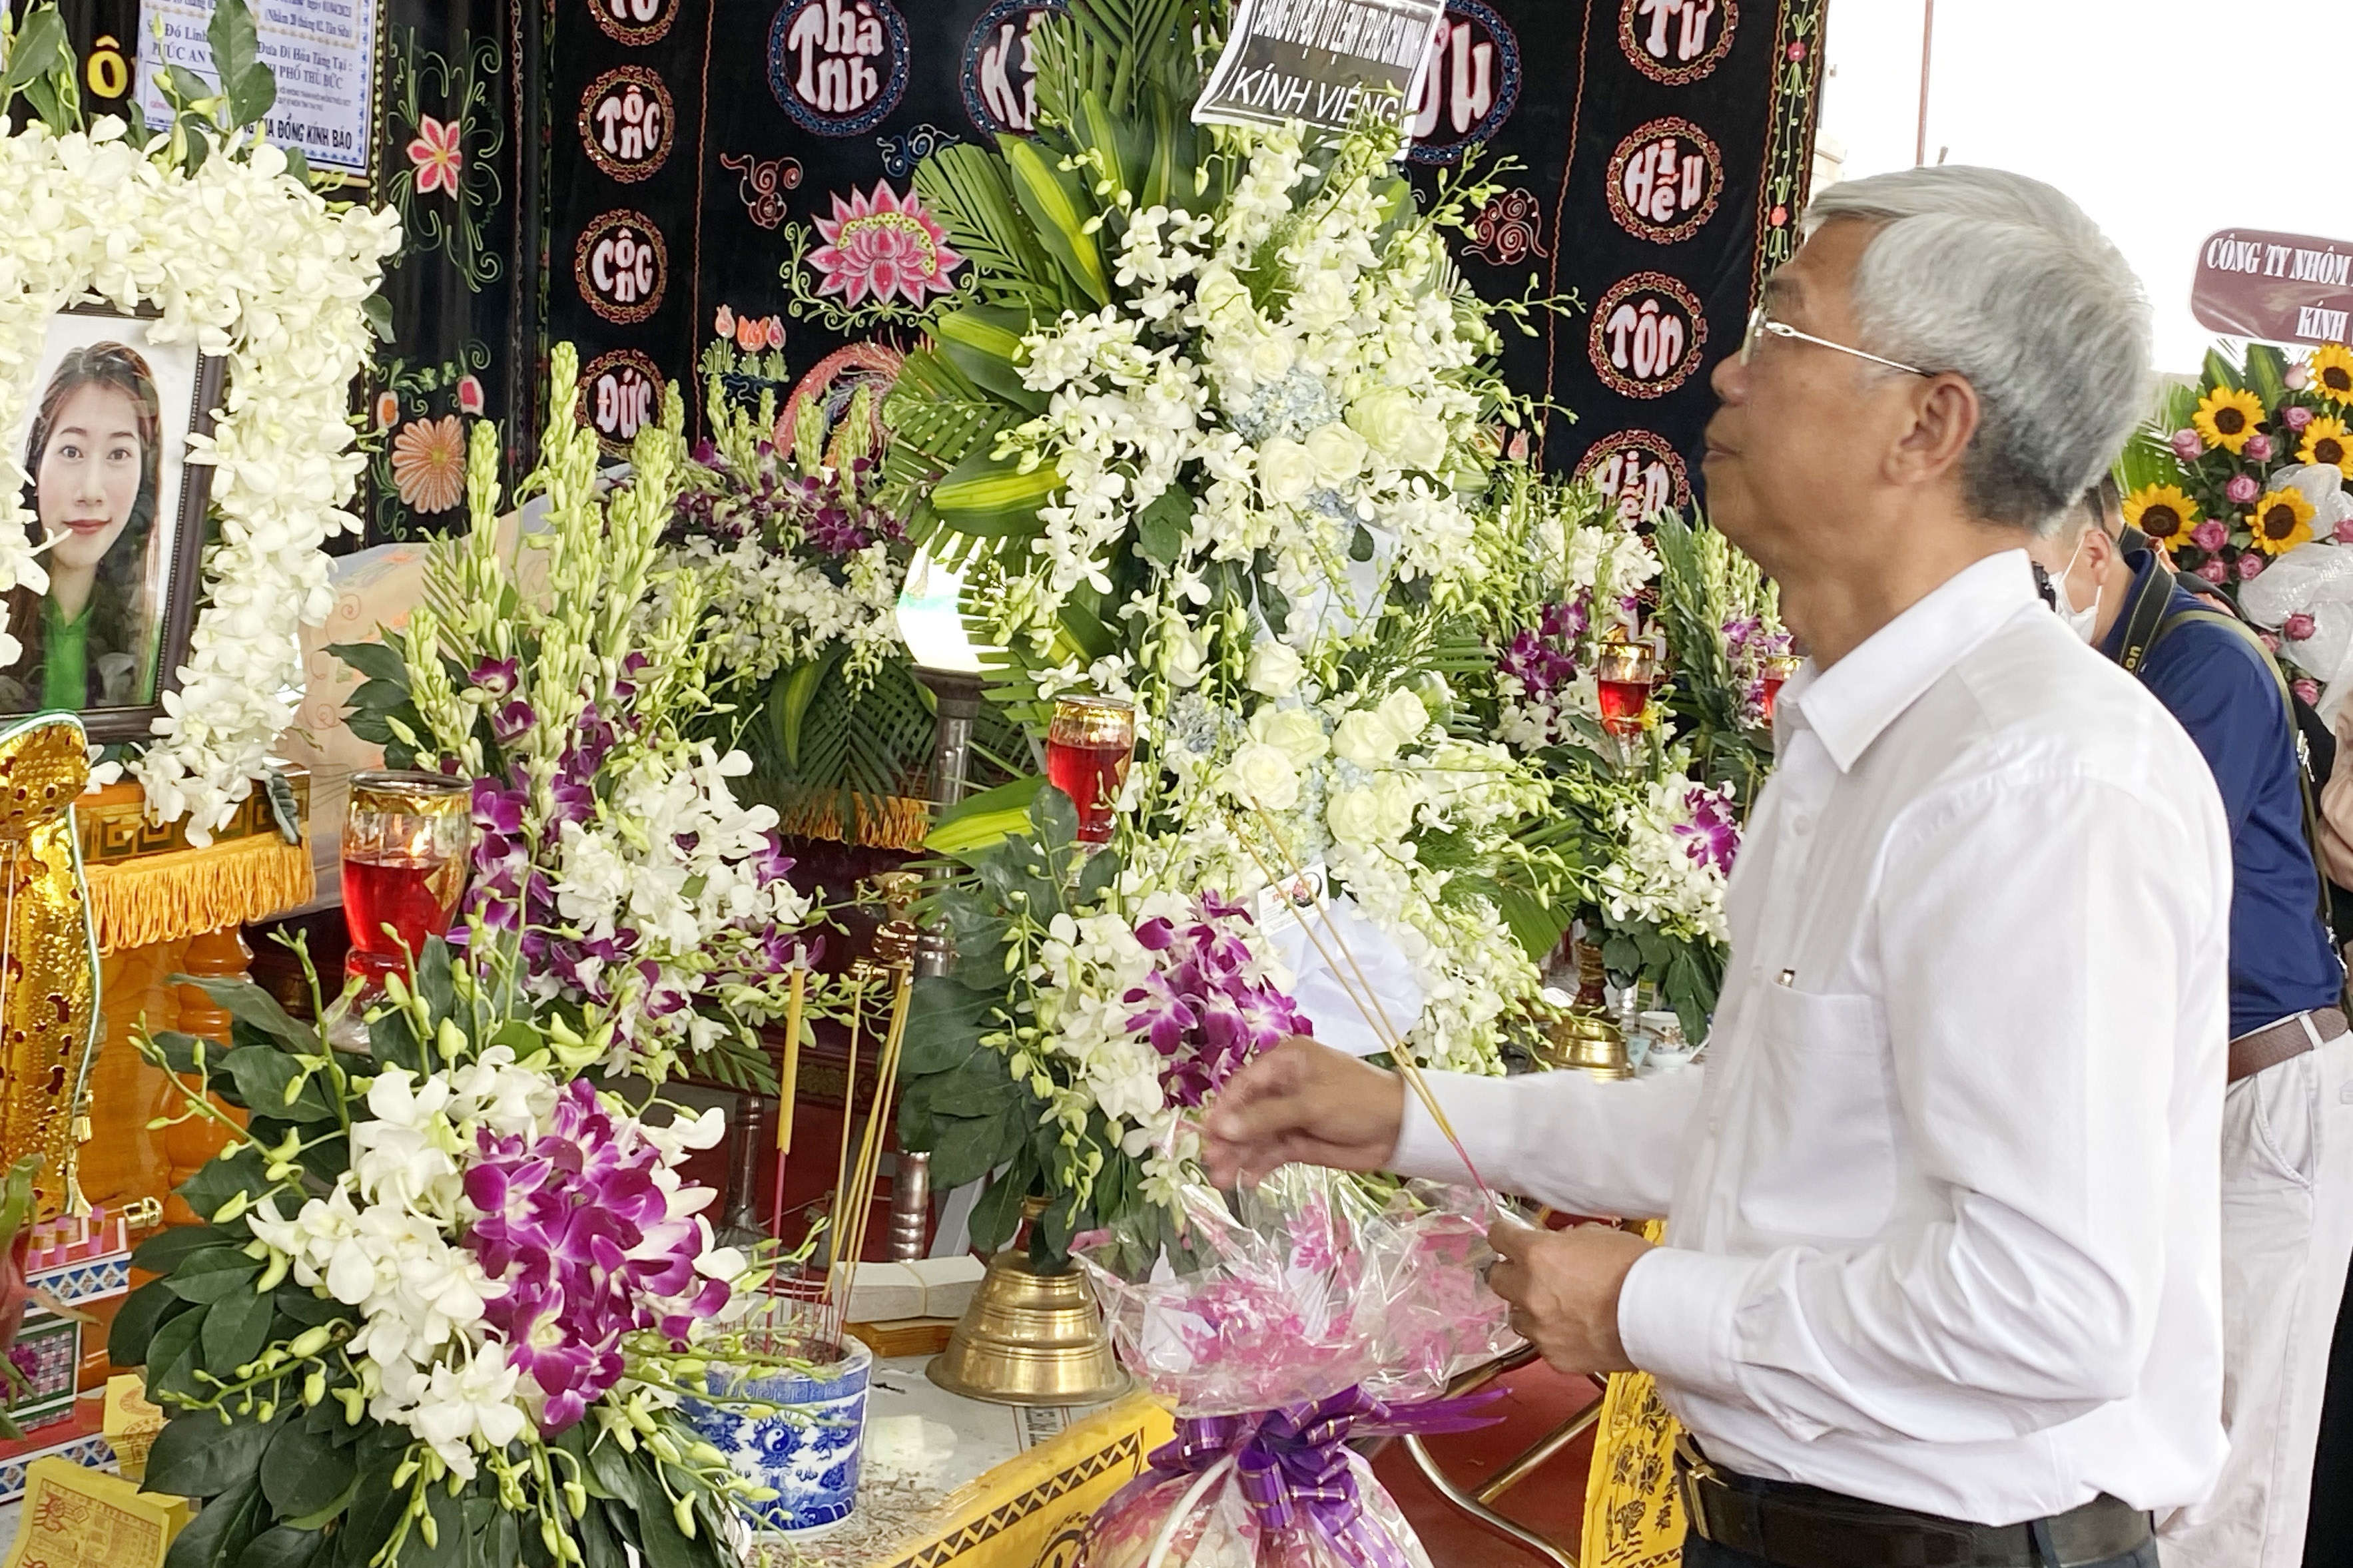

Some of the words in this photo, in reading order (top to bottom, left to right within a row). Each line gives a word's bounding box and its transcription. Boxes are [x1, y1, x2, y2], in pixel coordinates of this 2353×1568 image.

[1228, 63, 1313, 114] KÍNH
[1315, 81, 1399, 125] VIẾNG
[2206, 233, 2262, 274] CÔNG
[2263, 244, 2292, 278] TY
[2288, 245, 2353, 287] NHÔM
[2295, 300, 2349, 342] KÍNH
